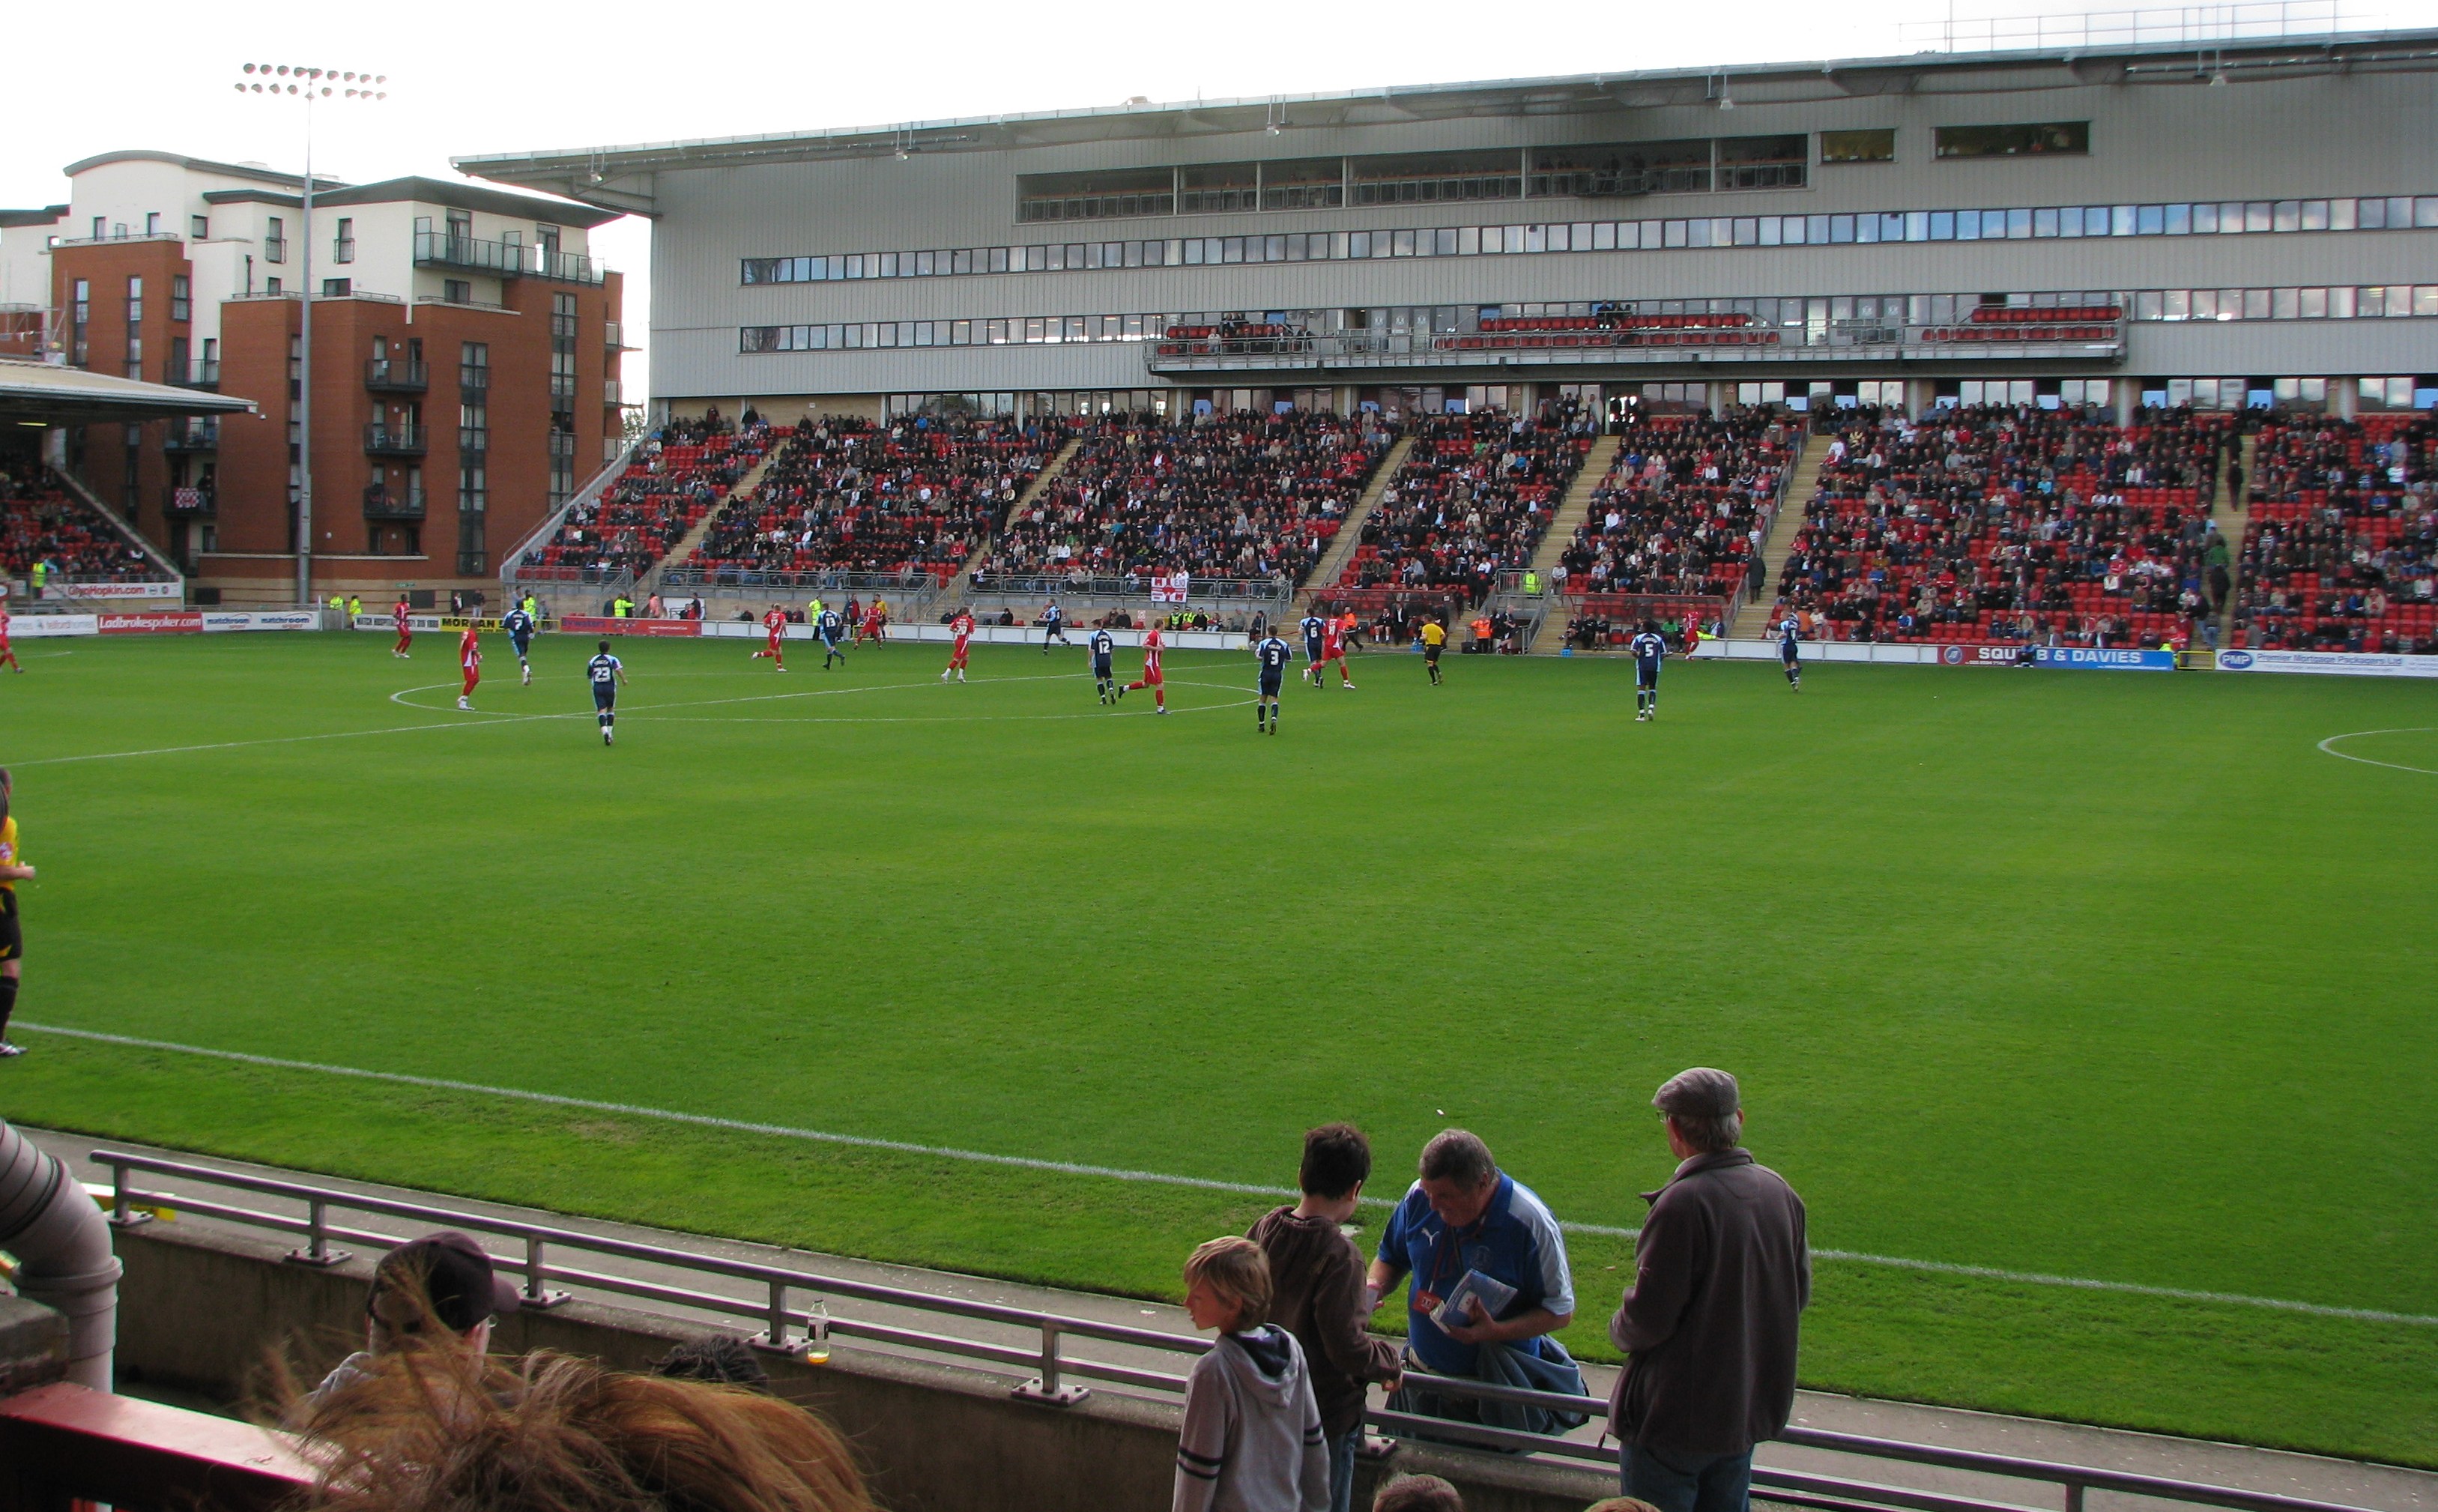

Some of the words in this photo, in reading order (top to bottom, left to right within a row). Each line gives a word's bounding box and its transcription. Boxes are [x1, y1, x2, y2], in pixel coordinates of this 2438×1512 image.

[99, 615, 201, 630] Ladbrokespoker.com
[441, 617, 495, 628] MORAN
[825, 617, 836, 628] 13
[956, 625, 967, 635] 20
[1310, 626, 1318, 638] 6
[1098, 641, 1110, 654] 12
[1645, 644, 1654, 657] 5
[1270, 650, 1279, 665] 3
[1978, 647, 2048, 661] SQUB
[2053, 650, 2066, 662] &
[2072, 650, 2141, 664] DAVIES
[2222, 654, 2249, 665] PMP
[2293, 655, 2335, 664] Mortgage
[593, 666, 611, 683] 23
